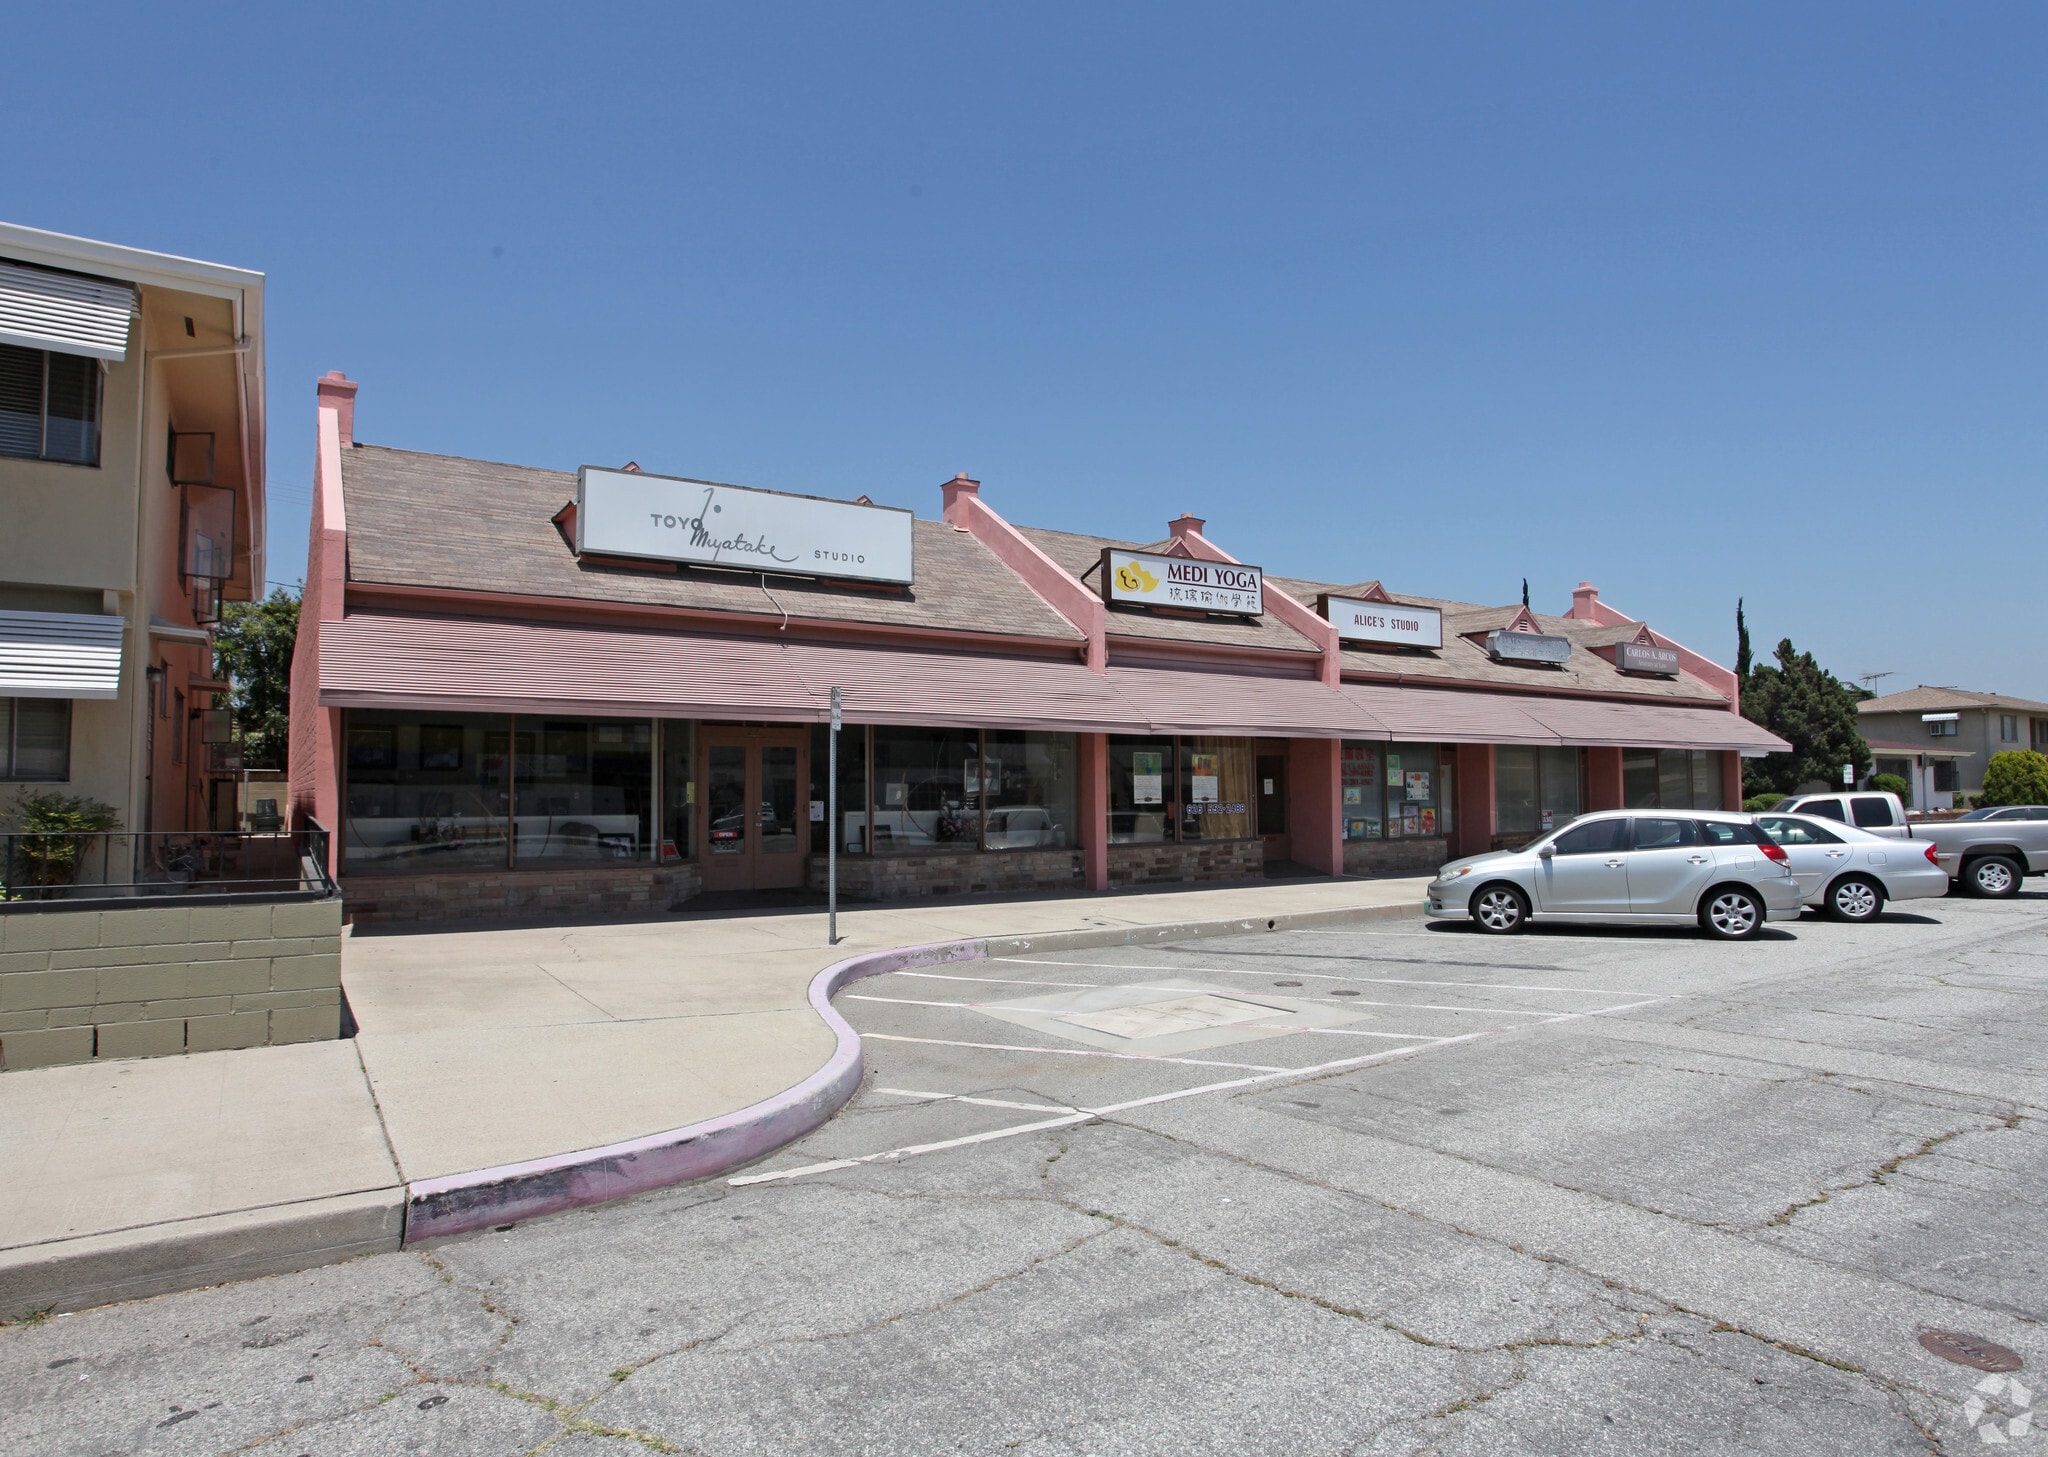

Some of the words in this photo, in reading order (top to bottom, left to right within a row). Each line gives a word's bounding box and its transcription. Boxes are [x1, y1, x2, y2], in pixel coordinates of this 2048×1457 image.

[650, 513, 703, 531] TOYO
[814, 550, 865, 564] STUDIO
[1167, 563, 1208, 583] MEDI
[1215, 569, 1257, 589] YOGA
[1354, 614, 1385, 628] ALICE'S
[1391, 618, 1419, 632] STUDIO
[1626, 646, 1650, 659] CARLOS
[1186, 803, 1203, 815] 626
